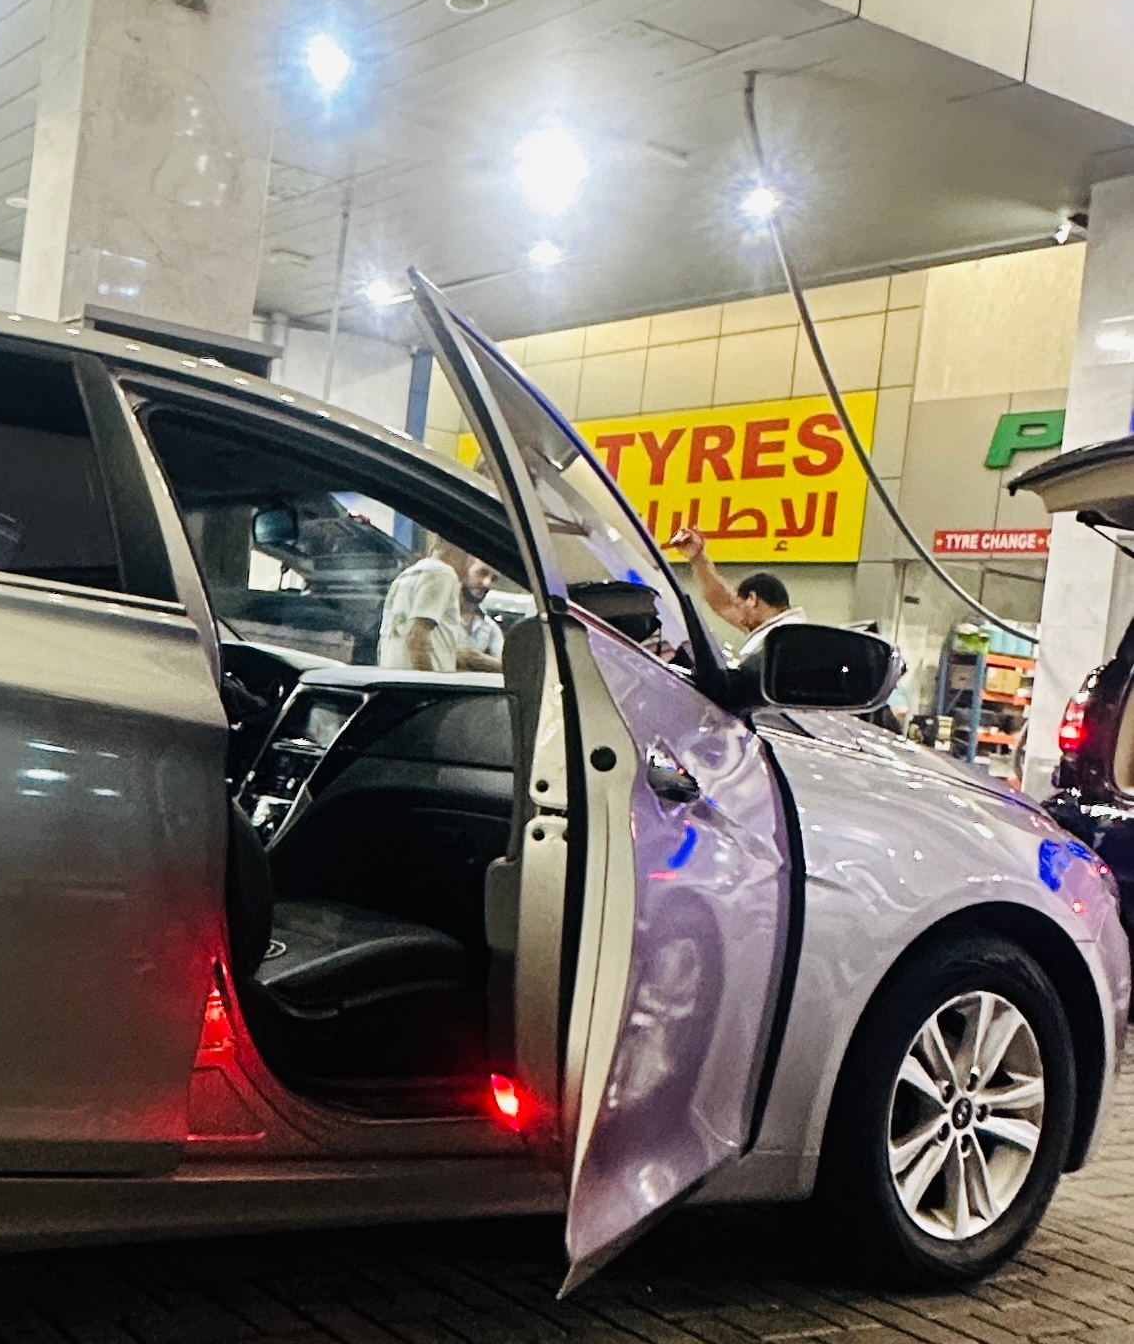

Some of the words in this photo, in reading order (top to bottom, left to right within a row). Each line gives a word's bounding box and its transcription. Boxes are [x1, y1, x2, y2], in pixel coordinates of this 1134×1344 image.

[595, 412, 845, 486] TYRES
[638, 491, 839, 552] الإطارا
[945, 534, 979, 549] TYRE
[981, 533, 1037, 549] CHANGE
